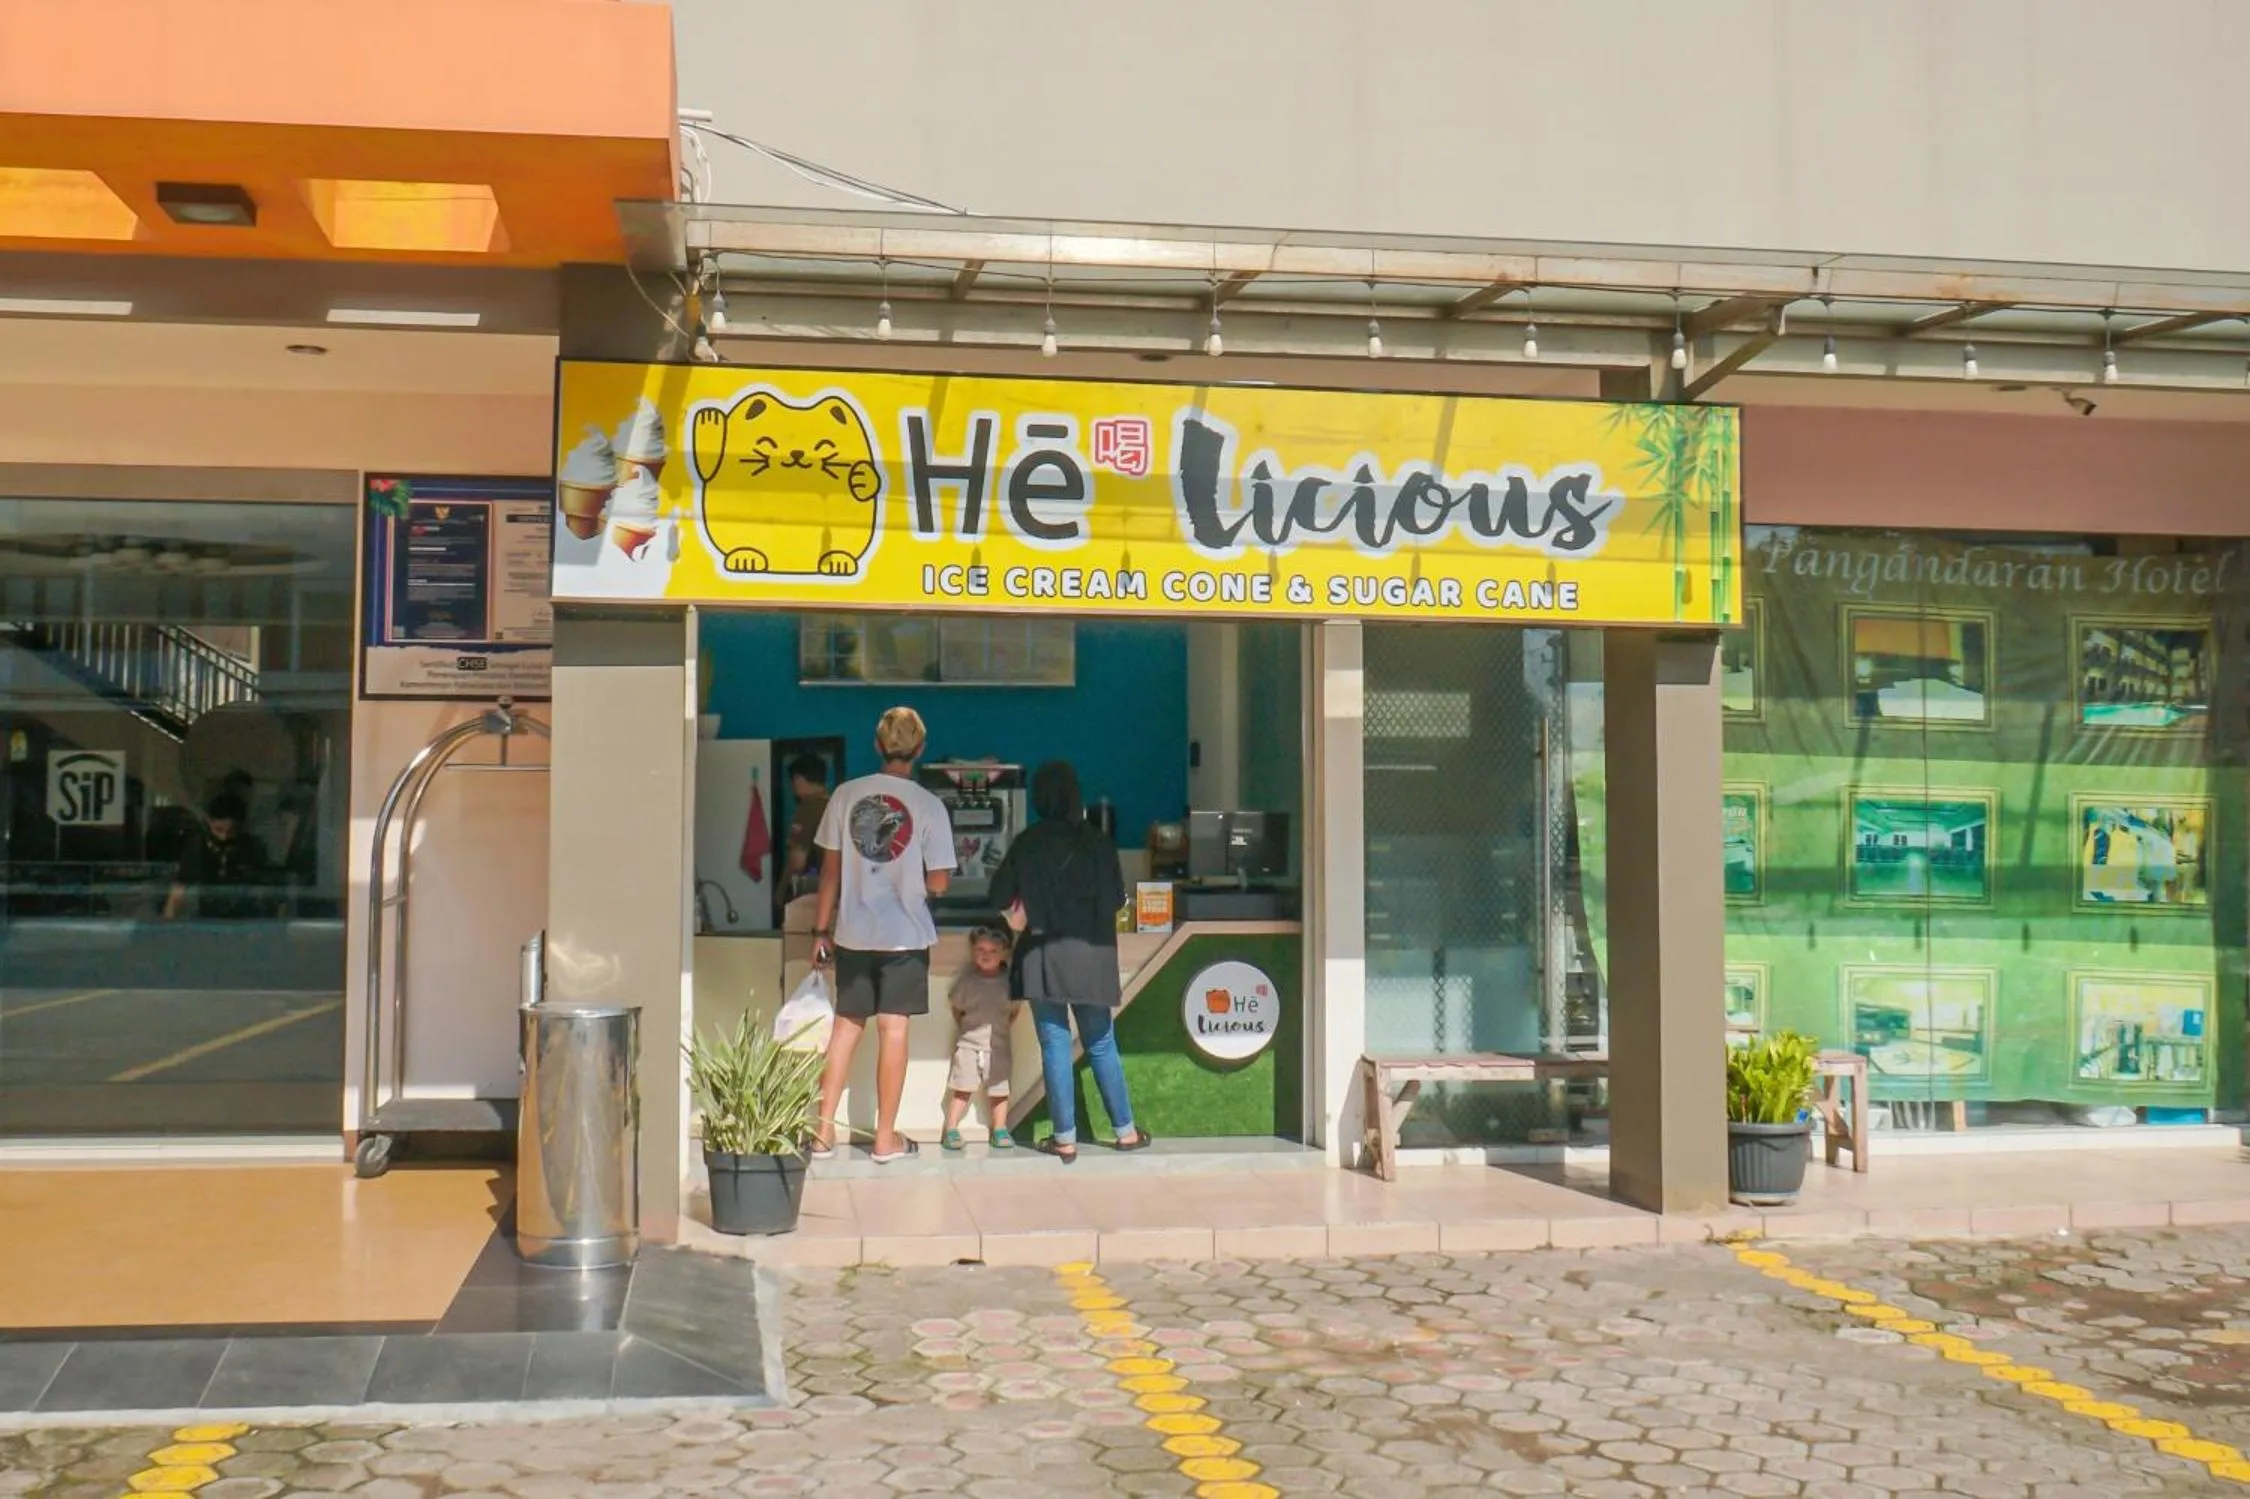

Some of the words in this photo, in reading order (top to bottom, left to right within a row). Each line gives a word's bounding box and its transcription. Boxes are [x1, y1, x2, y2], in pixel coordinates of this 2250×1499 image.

[1094, 419, 1150, 478] 喝
[923, 564, 989, 592] ICE
[1003, 567, 1148, 601] CREAM
[1161, 571, 1272, 605] CONE
[1286, 575, 1314, 604] &
[1326, 574, 1462, 609] SUGAR
[1476, 579, 1579, 611] CANE
[2100, 551, 2232, 595] Hotel
